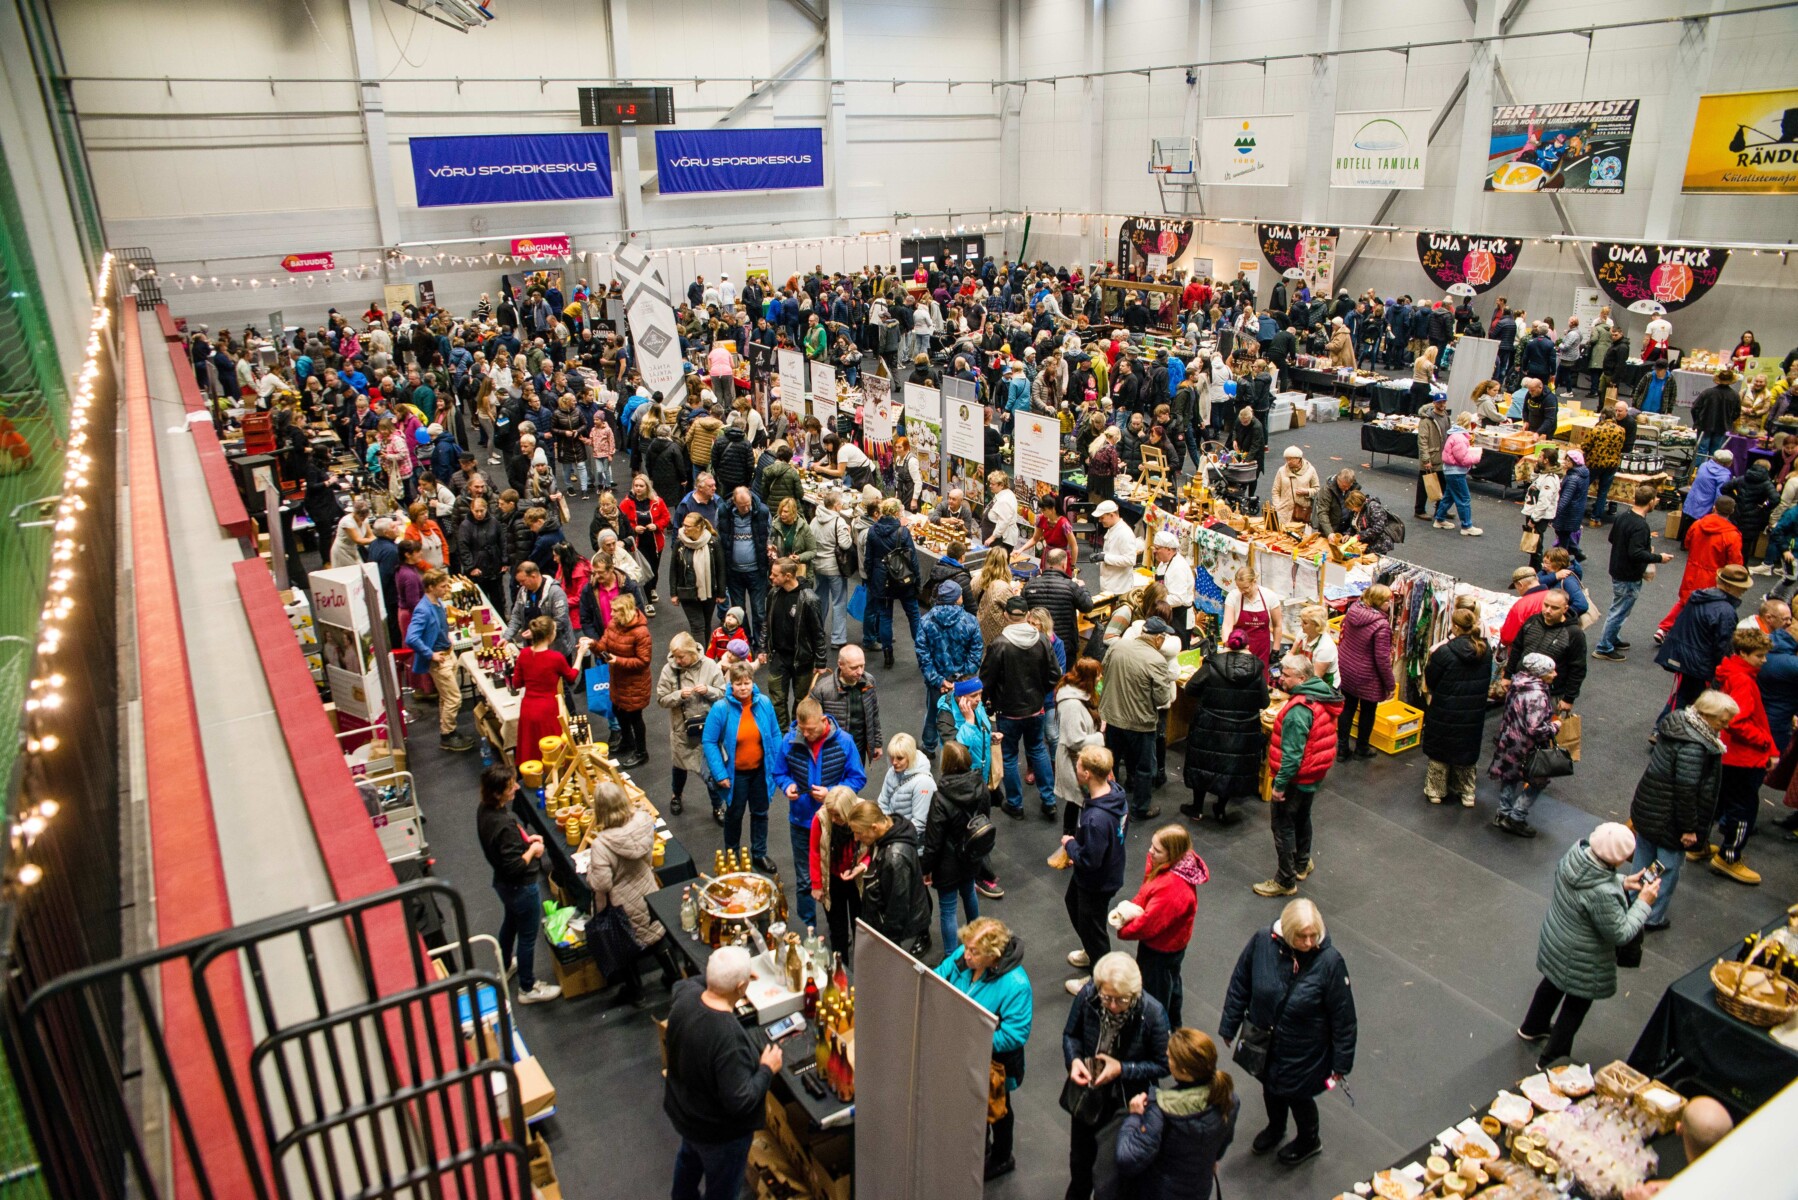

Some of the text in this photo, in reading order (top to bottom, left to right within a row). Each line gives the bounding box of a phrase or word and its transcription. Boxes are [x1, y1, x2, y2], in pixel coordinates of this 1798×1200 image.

[1493, 99, 1636, 120] TERE TULEMAST!
[1519, 117, 1547, 125] NOORTE
[669, 154, 812, 168] VÕRU SPORDIKESKUS
[1336, 156, 1420, 170] HOTELL TAMULA
[428, 162, 598, 178] VÕRU SPORDIKESKUS
[1721, 172, 1796, 186] Külalistemaja
[1136, 219, 1185, 234] UMA MEKK
[1268, 228, 1292, 240] UMA
[518, 242, 564, 254] MÄNGUMAA
[1429, 234, 1508, 254] UMA MEKK
[290, 257, 329, 268] BATUUDID
[1608, 246, 1711, 267] UMA MEKK
[593, 682, 610, 692] coo
